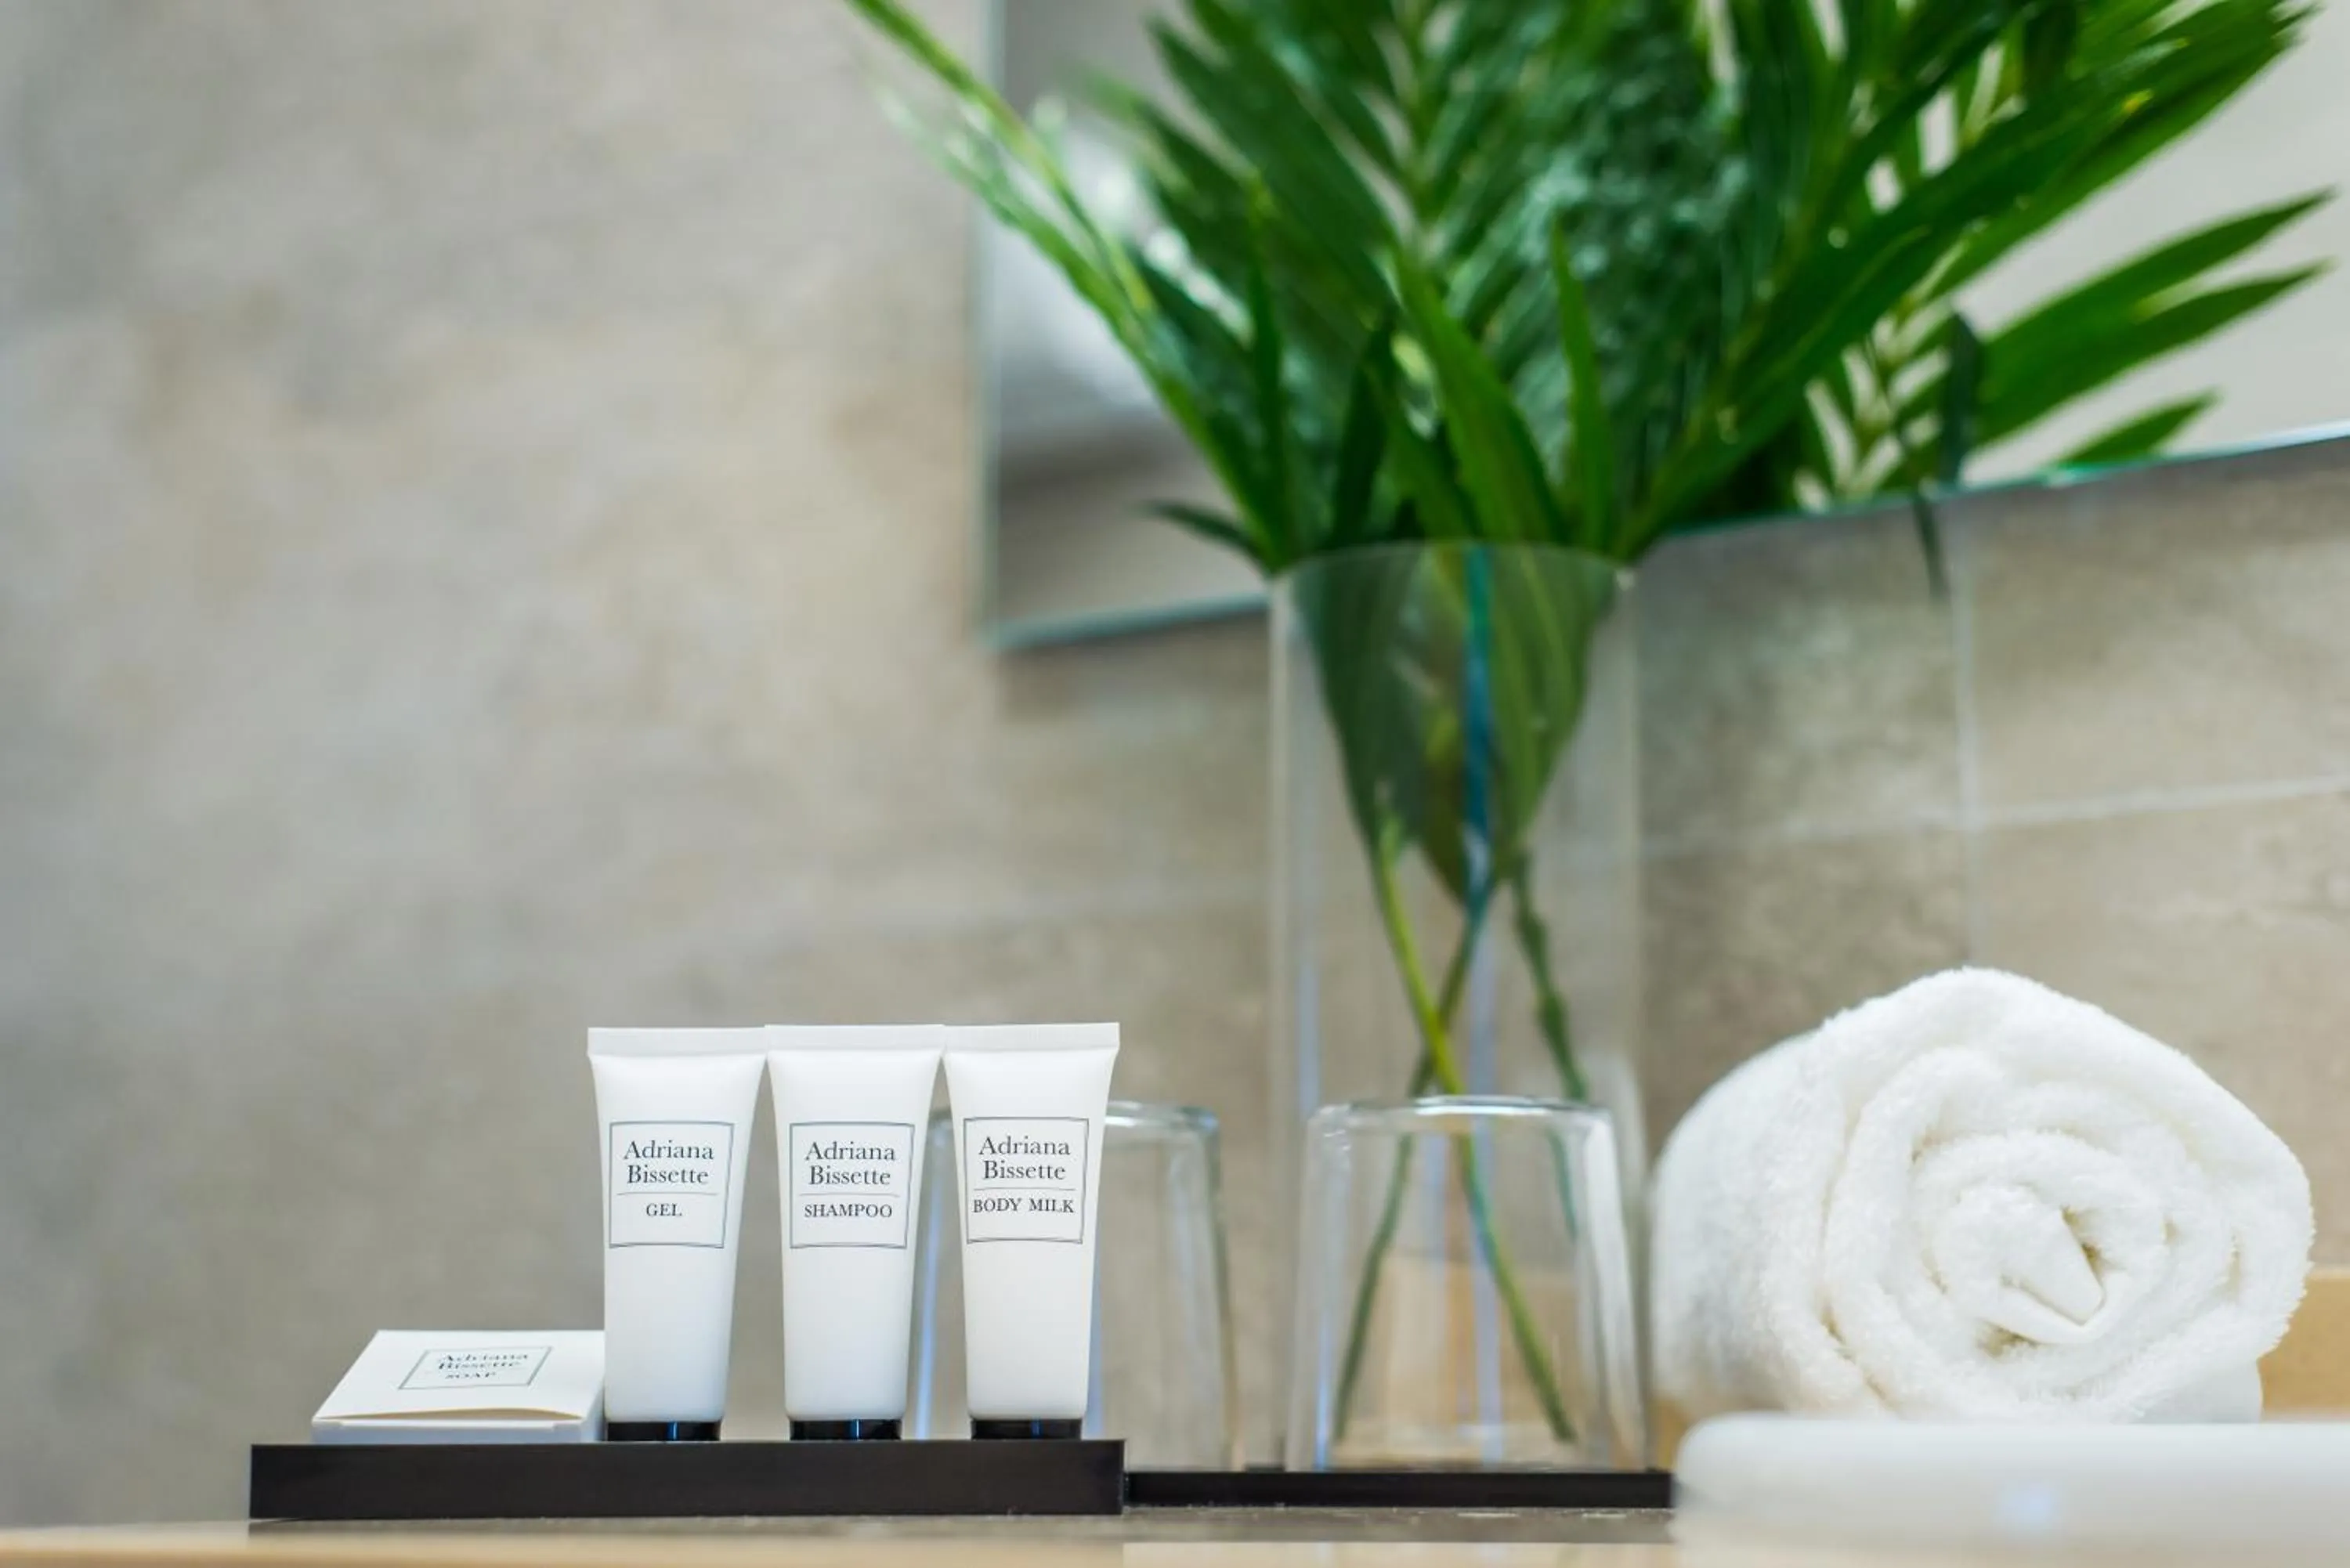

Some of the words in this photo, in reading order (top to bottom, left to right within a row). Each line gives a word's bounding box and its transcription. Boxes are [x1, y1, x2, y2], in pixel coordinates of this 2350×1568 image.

[623, 1140, 714, 1160] Adriana
[804, 1140, 896, 1162] Adriana
[978, 1135, 1071, 1156] Adriana
[626, 1163, 709, 1184] Bissette
[808, 1165, 891, 1186] Bissette
[982, 1159, 1066, 1180] Bissette
[645, 1203, 682, 1217] GEL
[804, 1203, 893, 1218] SHAMPOO
[972, 1198, 1022, 1213] BODY
[1029, 1198, 1075, 1213] MILK
